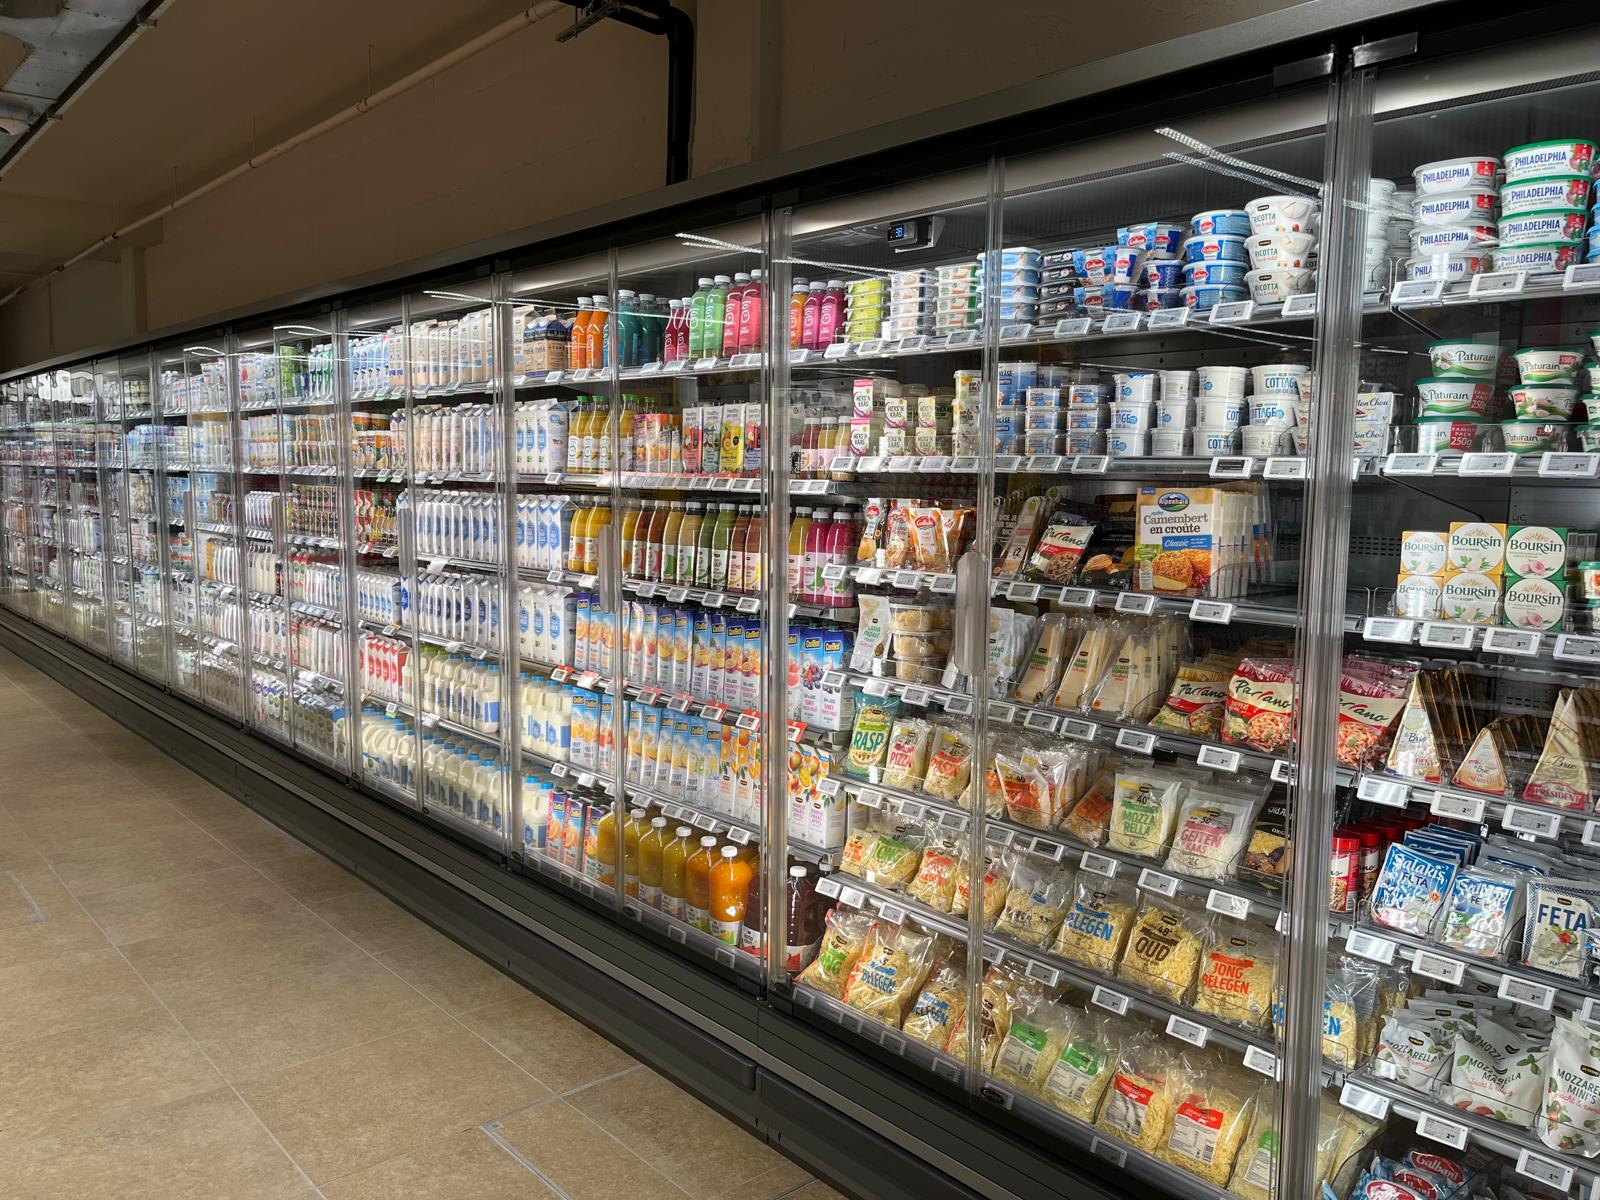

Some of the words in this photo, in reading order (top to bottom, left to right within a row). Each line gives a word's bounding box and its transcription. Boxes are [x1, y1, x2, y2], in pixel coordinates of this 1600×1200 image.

[1515, 151, 1567, 167] PHILADELPHIA
[1423, 168, 1470, 184] PHILADELPHIA
[1511, 186, 1564, 201] PHILADELPHIA
[1421, 200, 1470, 216] PHILADELPHIA
[1254, 212, 1276, 224] RICOTTA
[1508, 219, 1561, 235] PHILADELPHIA
[1420, 232, 1469, 247] PHILADELPHIA
[1254, 248, 1279, 258] RICOTTA
[1415, 262, 1464, 278] PHILAPHIA
[1254, 283, 1279, 291] RICOTTA
[1456, 351, 1496, 362] Paturain
[1524, 360, 1561, 371] Paturain
[1428, 390, 1469, 401] Paturain
[1451, 436, 1473, 448] 250g
[1506, 433, 1538, 443] Paturain
[1143, 513, 1209, 525] Camembert
[1150, 526, 1163, 534] en
[1164, 523, 1201, 534] croûte
[1164, 539, 1190, 548] Classic
[1404, 541, 1444, 554] Boursin
[1452, 535, 1503, 550] Boursin
[1510, 538, 1563, 554] Boursin
[1446, 584, 1497, 600] Boursin
[1508, 590, 1563, 607] Boursin
[1235, 679, 1291, 708] Parrano
[853, 731, 886, 752] RASP
[890, 752, 913, 768] PIZZA
[1551, 754, 1577, 769] Brie
[1123, 810, 1157, 827] MOZZA
[1124, 822, 1151, 836] RELLA
[1181, 829, 1224, 849] GEITEN
[1394, 853, 1447, 884] Salakis
[1402, 873, 1429, 889] FETA
[1537, 902, 1587, 931] FETA
[1135, 936, 1171, 962] OUD
[1213, 961, 1245, 980] JONG
[1202, 973, 1250, 996] BELEGEN
[1385, 1039, 1438, 1064] MOZZARELLA
[1557, 1067, 1600, 1094] MOZZARE
[1566, 1084, 1597, 1105] MINI'S
[1416, 1155, 1459, 1181] Galbani
